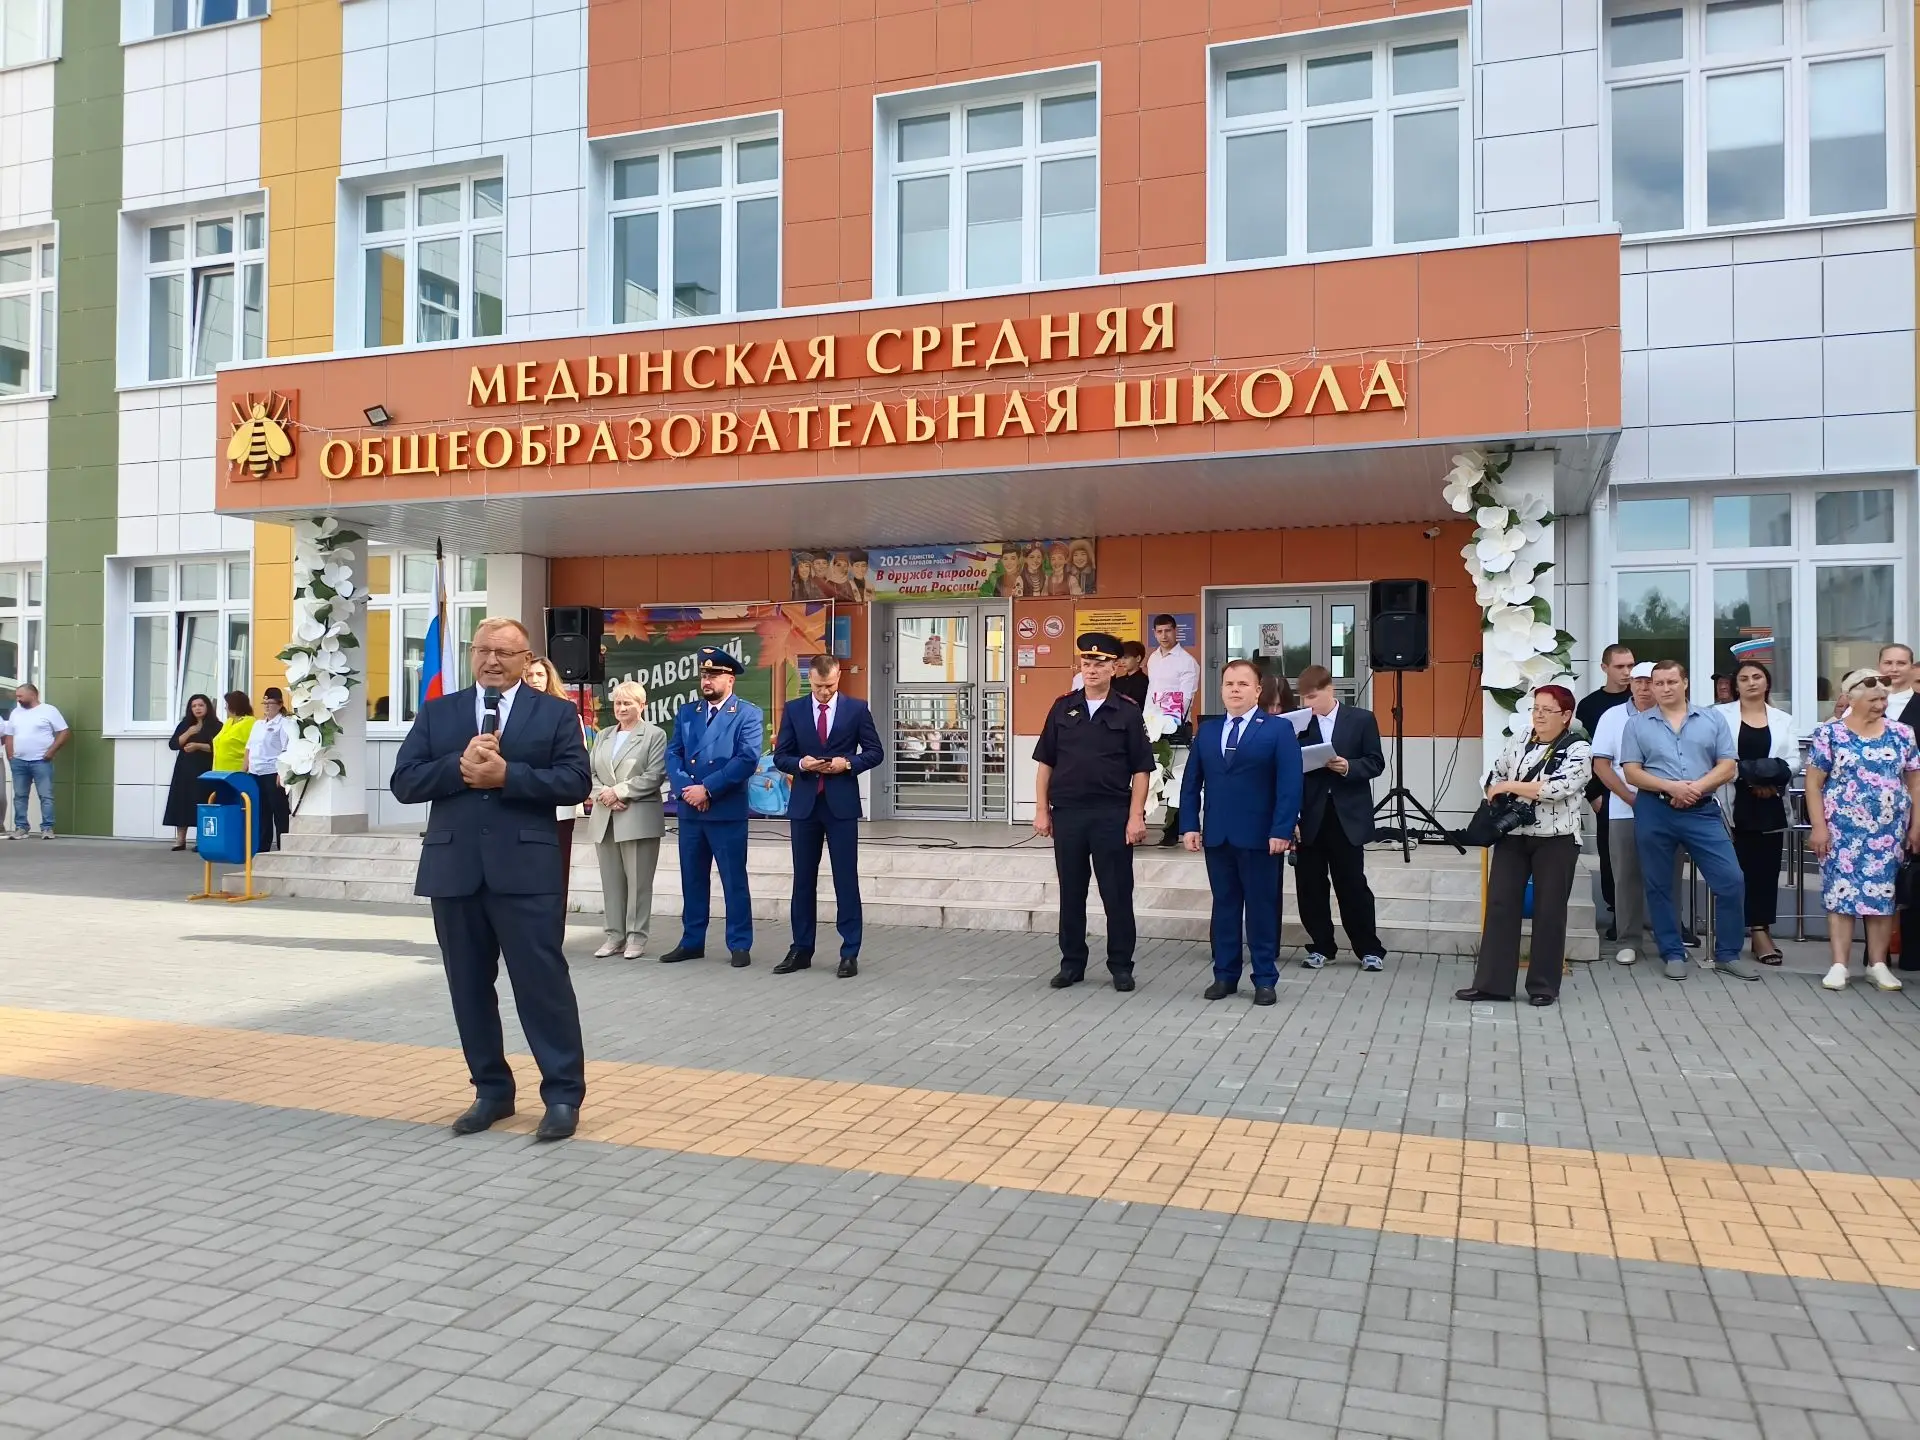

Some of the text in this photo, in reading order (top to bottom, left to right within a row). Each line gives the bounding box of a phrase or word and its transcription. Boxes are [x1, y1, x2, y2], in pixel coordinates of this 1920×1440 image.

[467, 301, 1175, 406] МЕДЫНСКАЯ СРЕДНЯЯ
[318, 359, 1407, 480] ОБЩЕОБРАЗОВАТЕЛЬНАЯ ШКОЛА
[880, 555, 909, 567] 2026
[876, 566, 988, 583] В дружбе народов
[898, 581, 980, 594] сила России!
